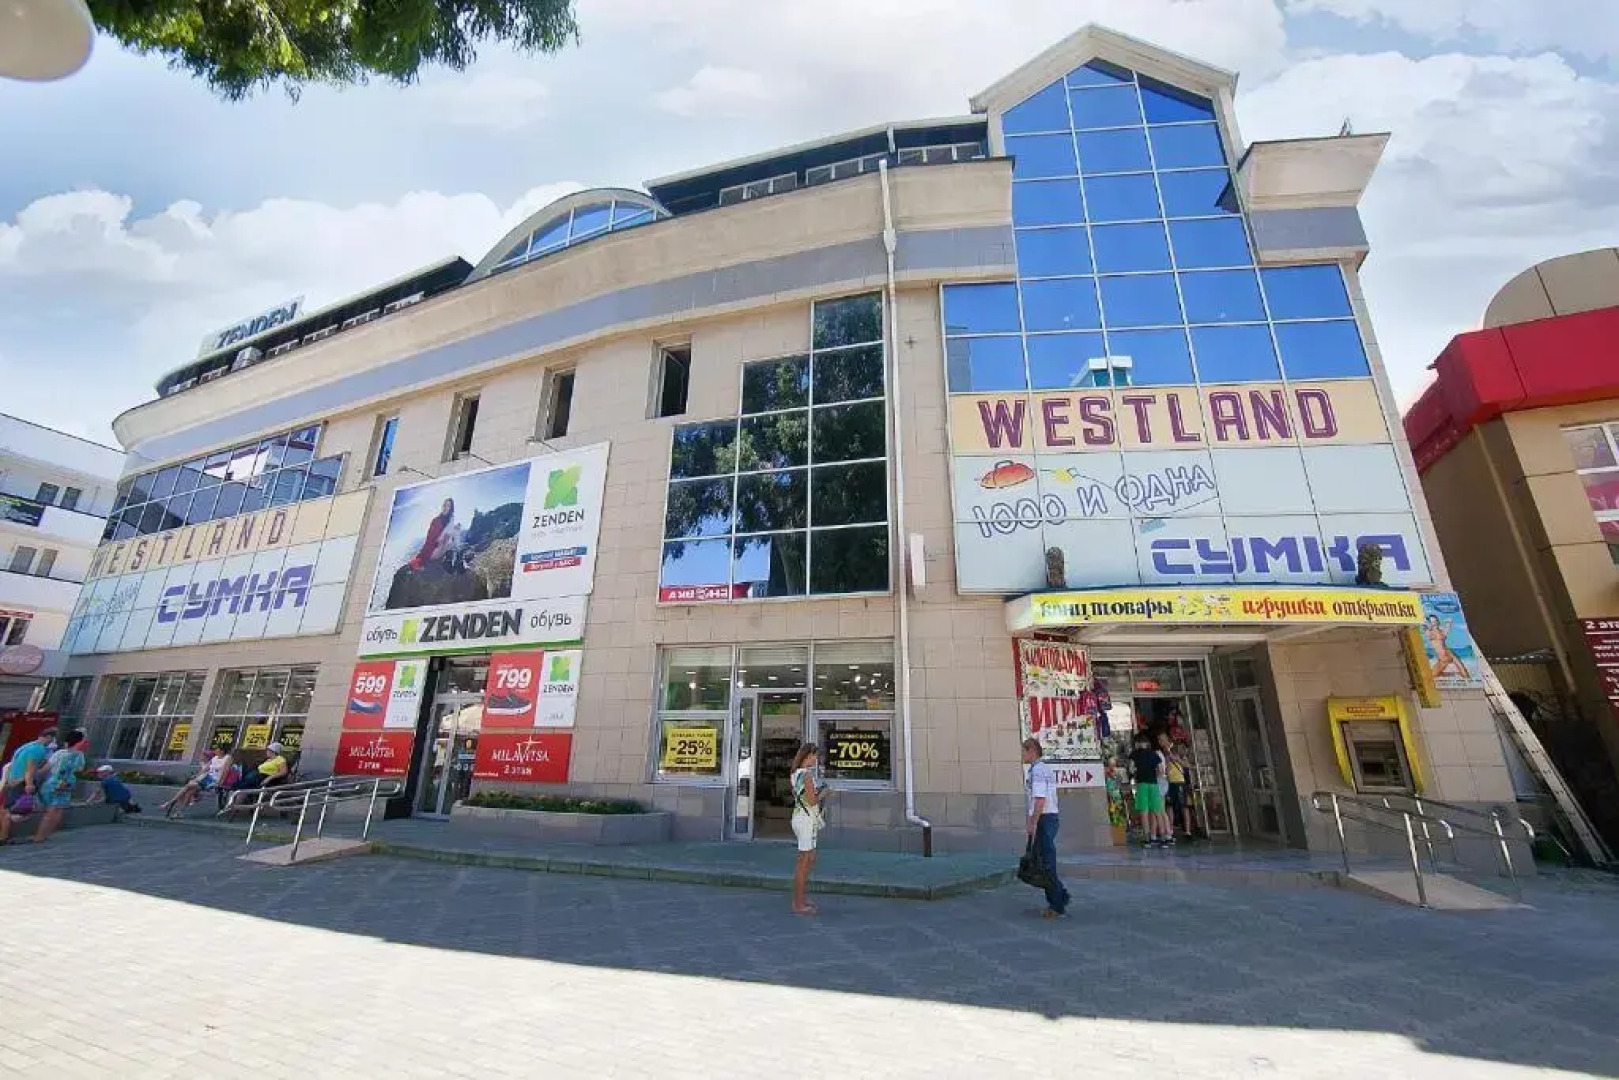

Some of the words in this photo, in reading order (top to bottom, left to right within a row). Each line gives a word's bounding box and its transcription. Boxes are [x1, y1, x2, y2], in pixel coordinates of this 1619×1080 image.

[979, 388, 1338, 449] WESTLAND
[1077, 485, 1108, 516] И
[1115, 465, 1214, 510] ОДНА
[532, 509, 584, 529] ZENDEN
[1150, 535, 1411, 575] СУМКА
[157, 564, 313, 624] СУМКА
[1242, 597, 1326, 618] игрушки
[1332, 600, 1417, 620] открытки
[419, 608, 523, 643] ZENDEN
[530, 611, 572, 630] обувь
[355, 675, 387, 694] 599
[496, 667, 532, 689] 799
[491, 742, 550, 764] MILAVITSA
[670, 739, 713, 755] -25%
[829, 742, 880, 759] -70%
[503, 765, 511, 774] 2
